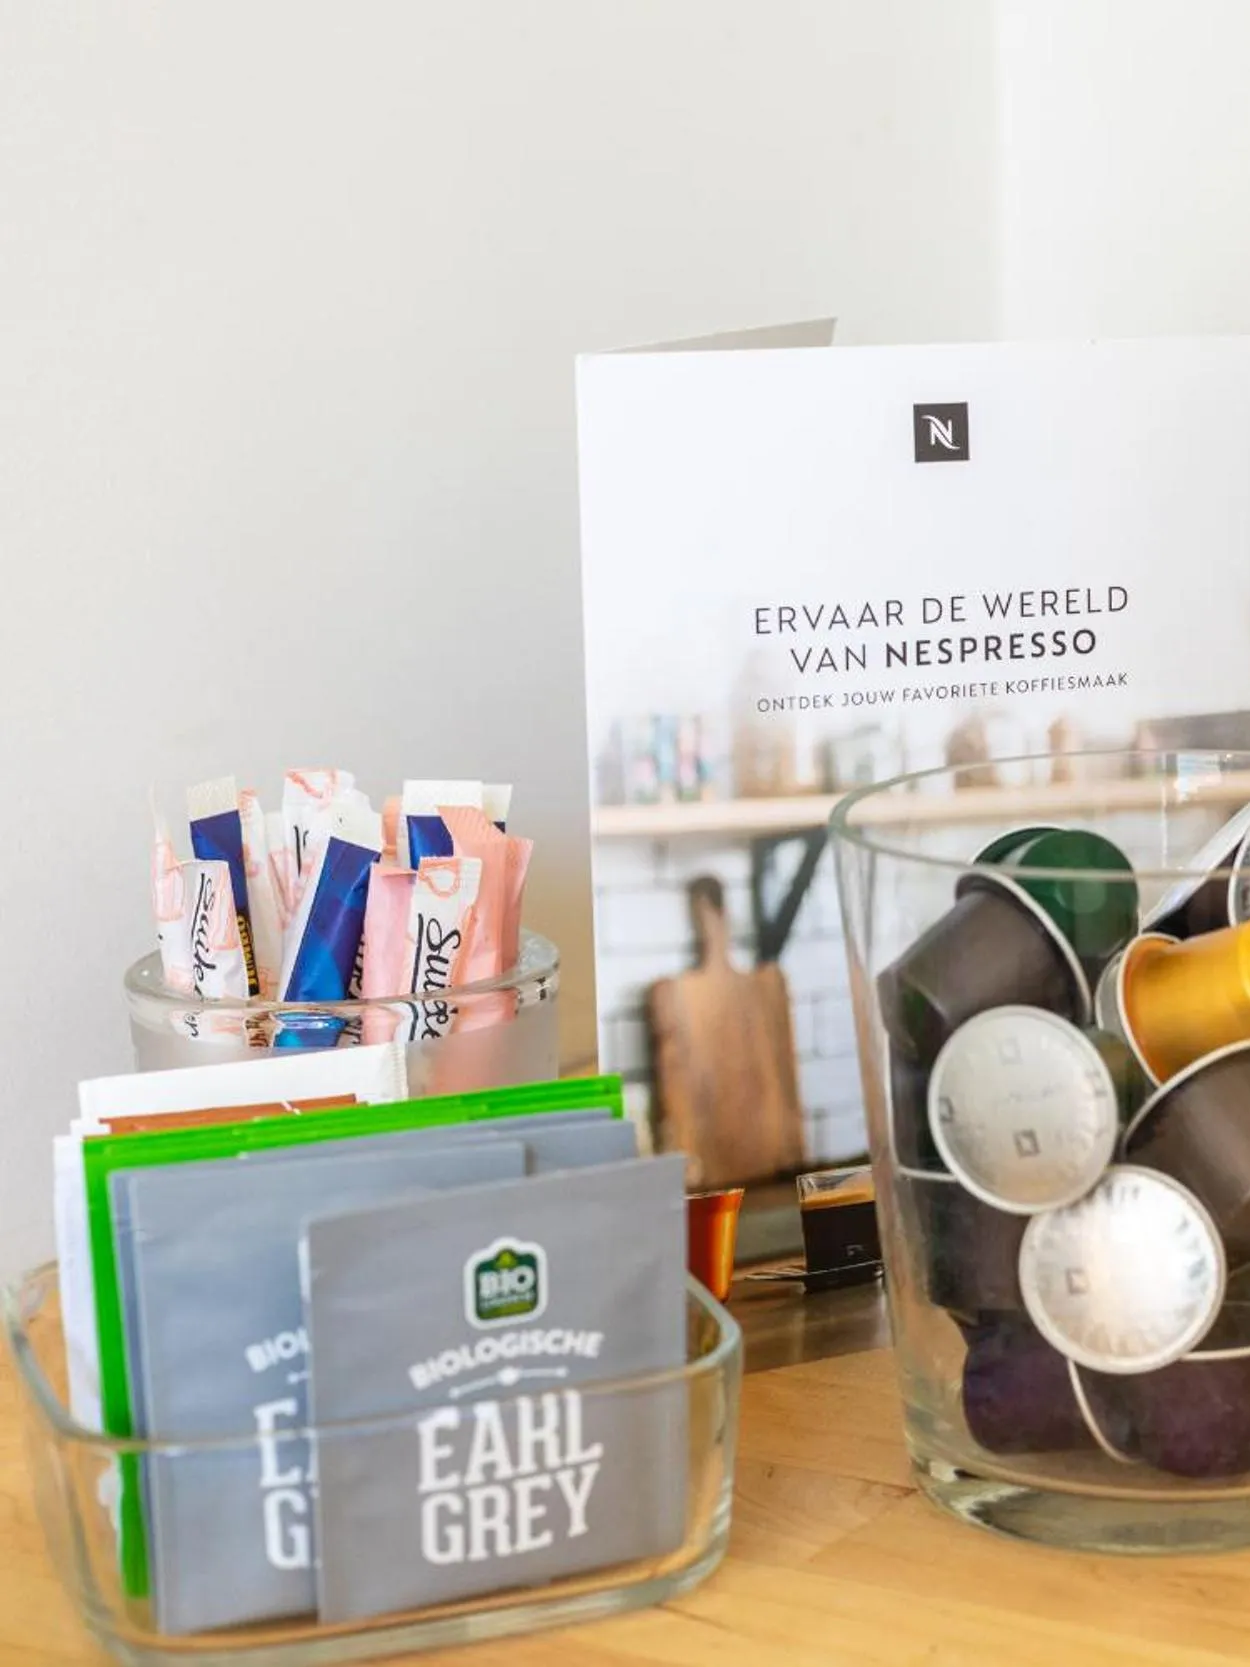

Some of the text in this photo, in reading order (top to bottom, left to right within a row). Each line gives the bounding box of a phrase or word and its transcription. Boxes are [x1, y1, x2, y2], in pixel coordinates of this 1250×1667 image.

[755, 586, 1129, 635] ERVAAR DE WERELD
[790, 628, 1097, 674] VAN NESPRESSO
[757, 671, 1129, 713] ONTDEK JOUW FAVORIETE KOFFIESMAAK
[479, 1265, 536, 1298] BIO
[408, 1328, 605, 1391] BIOLOGISCHE
[416, 1388, 603, 1494] EARL
[421, 1461, 602, 1565] GREY
